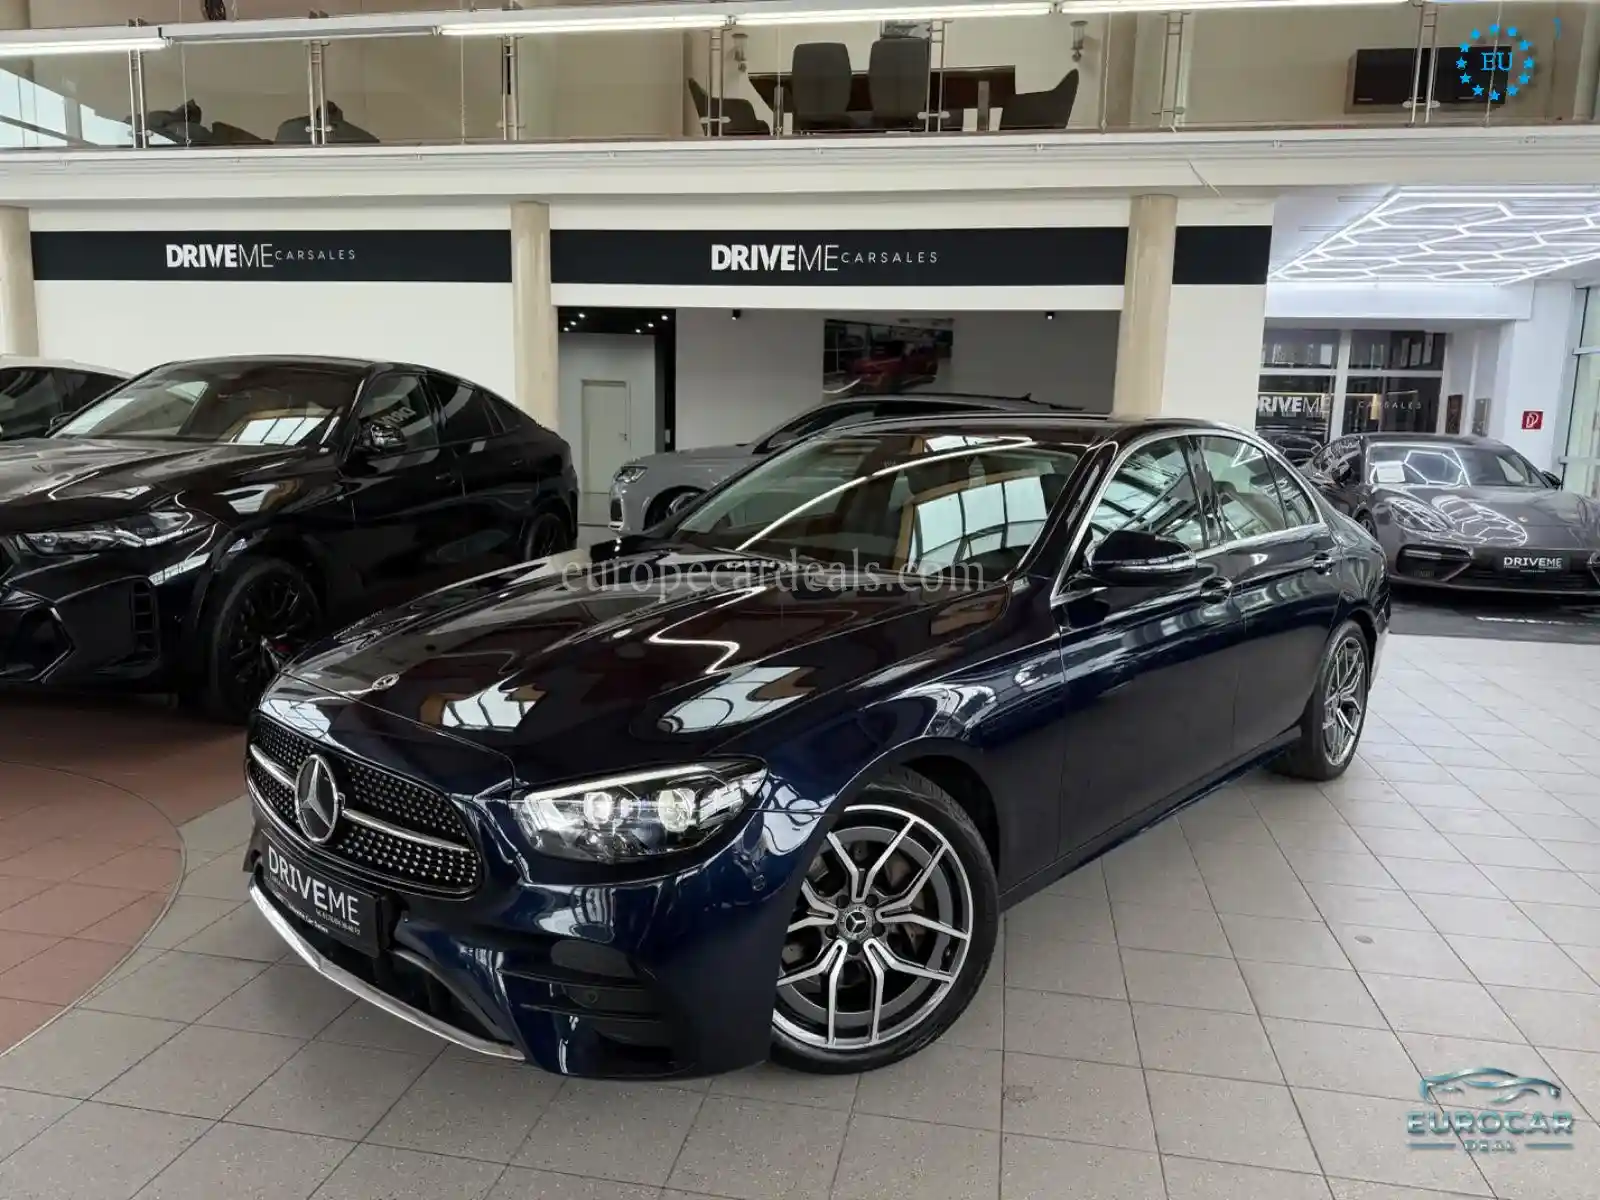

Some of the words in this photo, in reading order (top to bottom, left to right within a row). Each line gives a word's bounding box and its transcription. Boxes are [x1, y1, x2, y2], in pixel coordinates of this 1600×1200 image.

[166, 243, 274, 268] DRIVEME
[274, 249, 356, 261] CARSALES
[710, 244, 839, 272] DRIVEME
[840, 251, 939, 264] CARSALES
[1257, 395, 1330, 413] RIVEME
[1503, 556, 1563, 567] DRIVEME
[268, 844, 361, 926] DRIVEME
